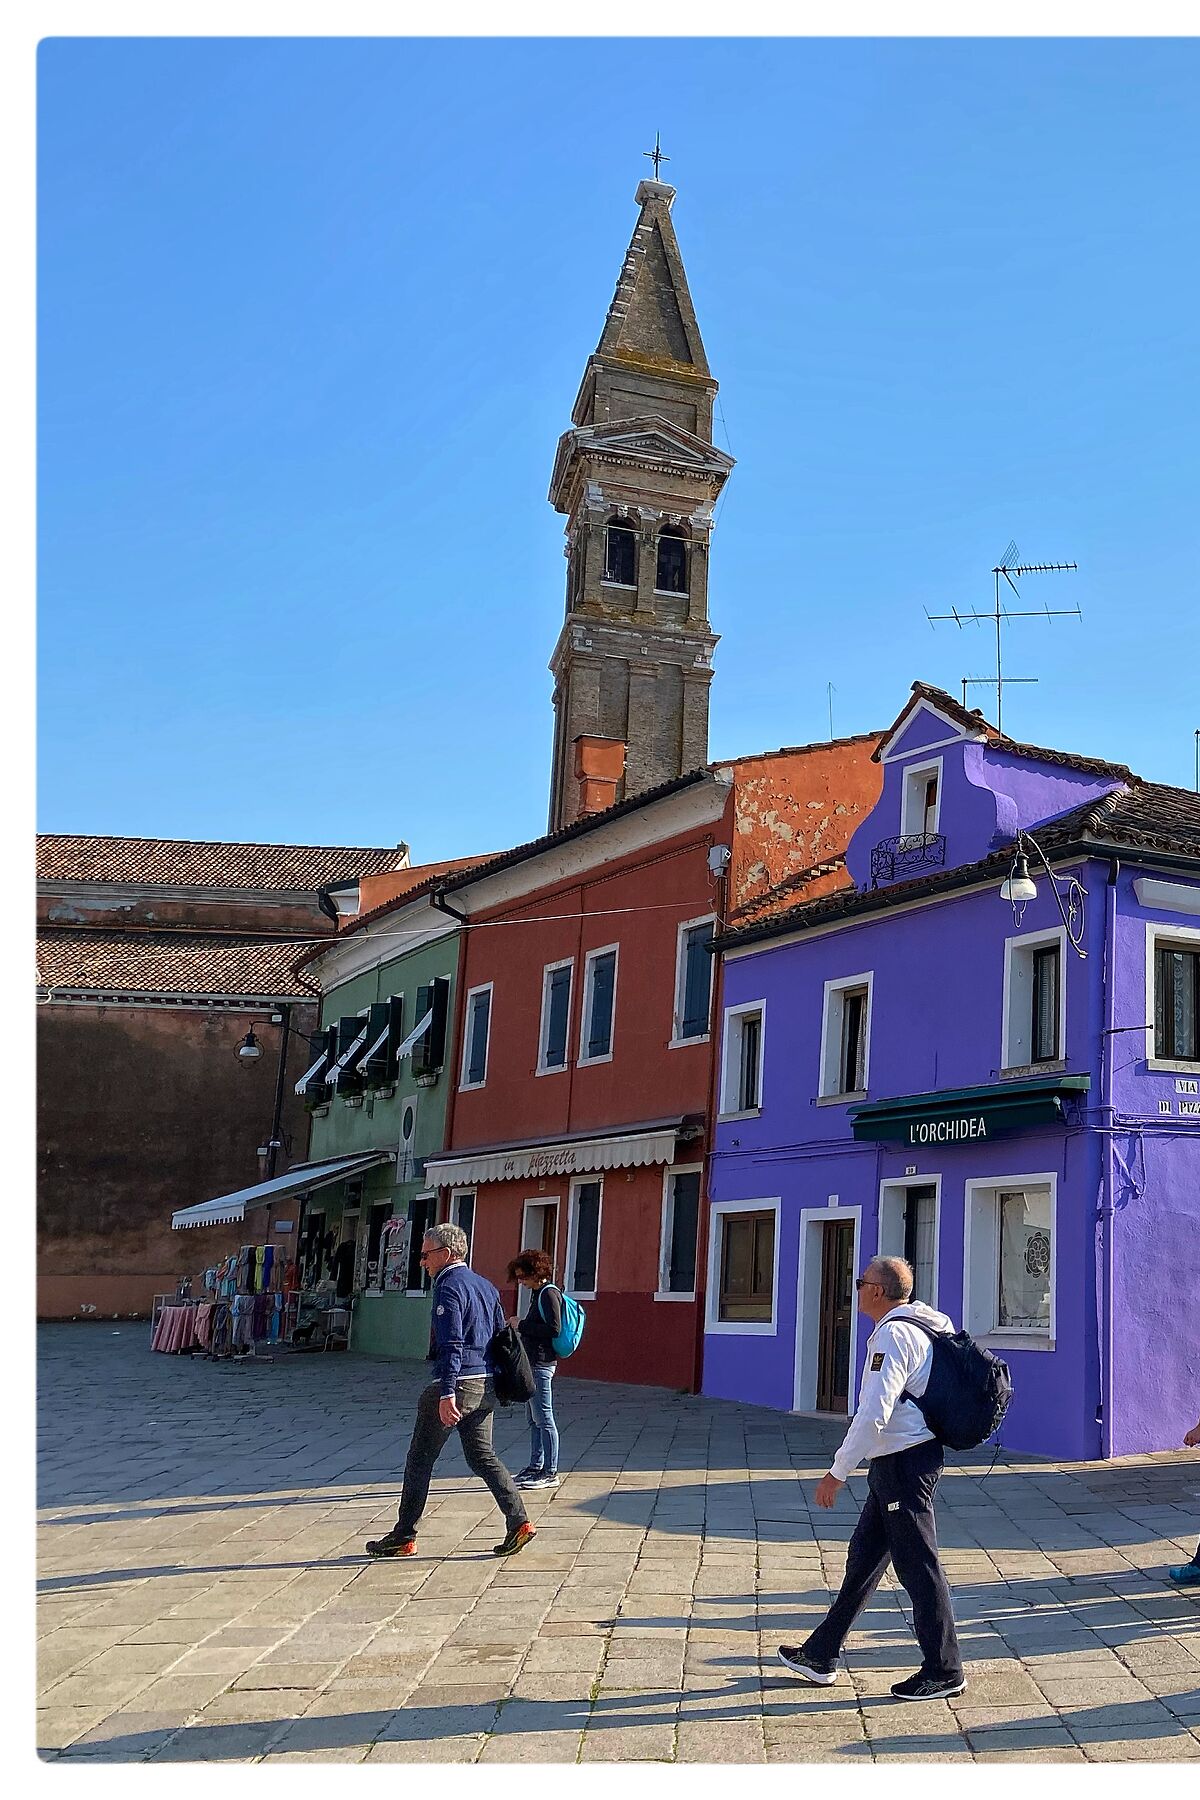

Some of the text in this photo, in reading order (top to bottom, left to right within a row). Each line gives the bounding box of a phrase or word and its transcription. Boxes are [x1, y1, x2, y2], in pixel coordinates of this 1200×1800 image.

[1179, 1080, 1197, 1093] VIA
[910, 1117, 987, 1143] L'ORCHIDEA
[504, 1149, 577, 1174] in piazzetta
